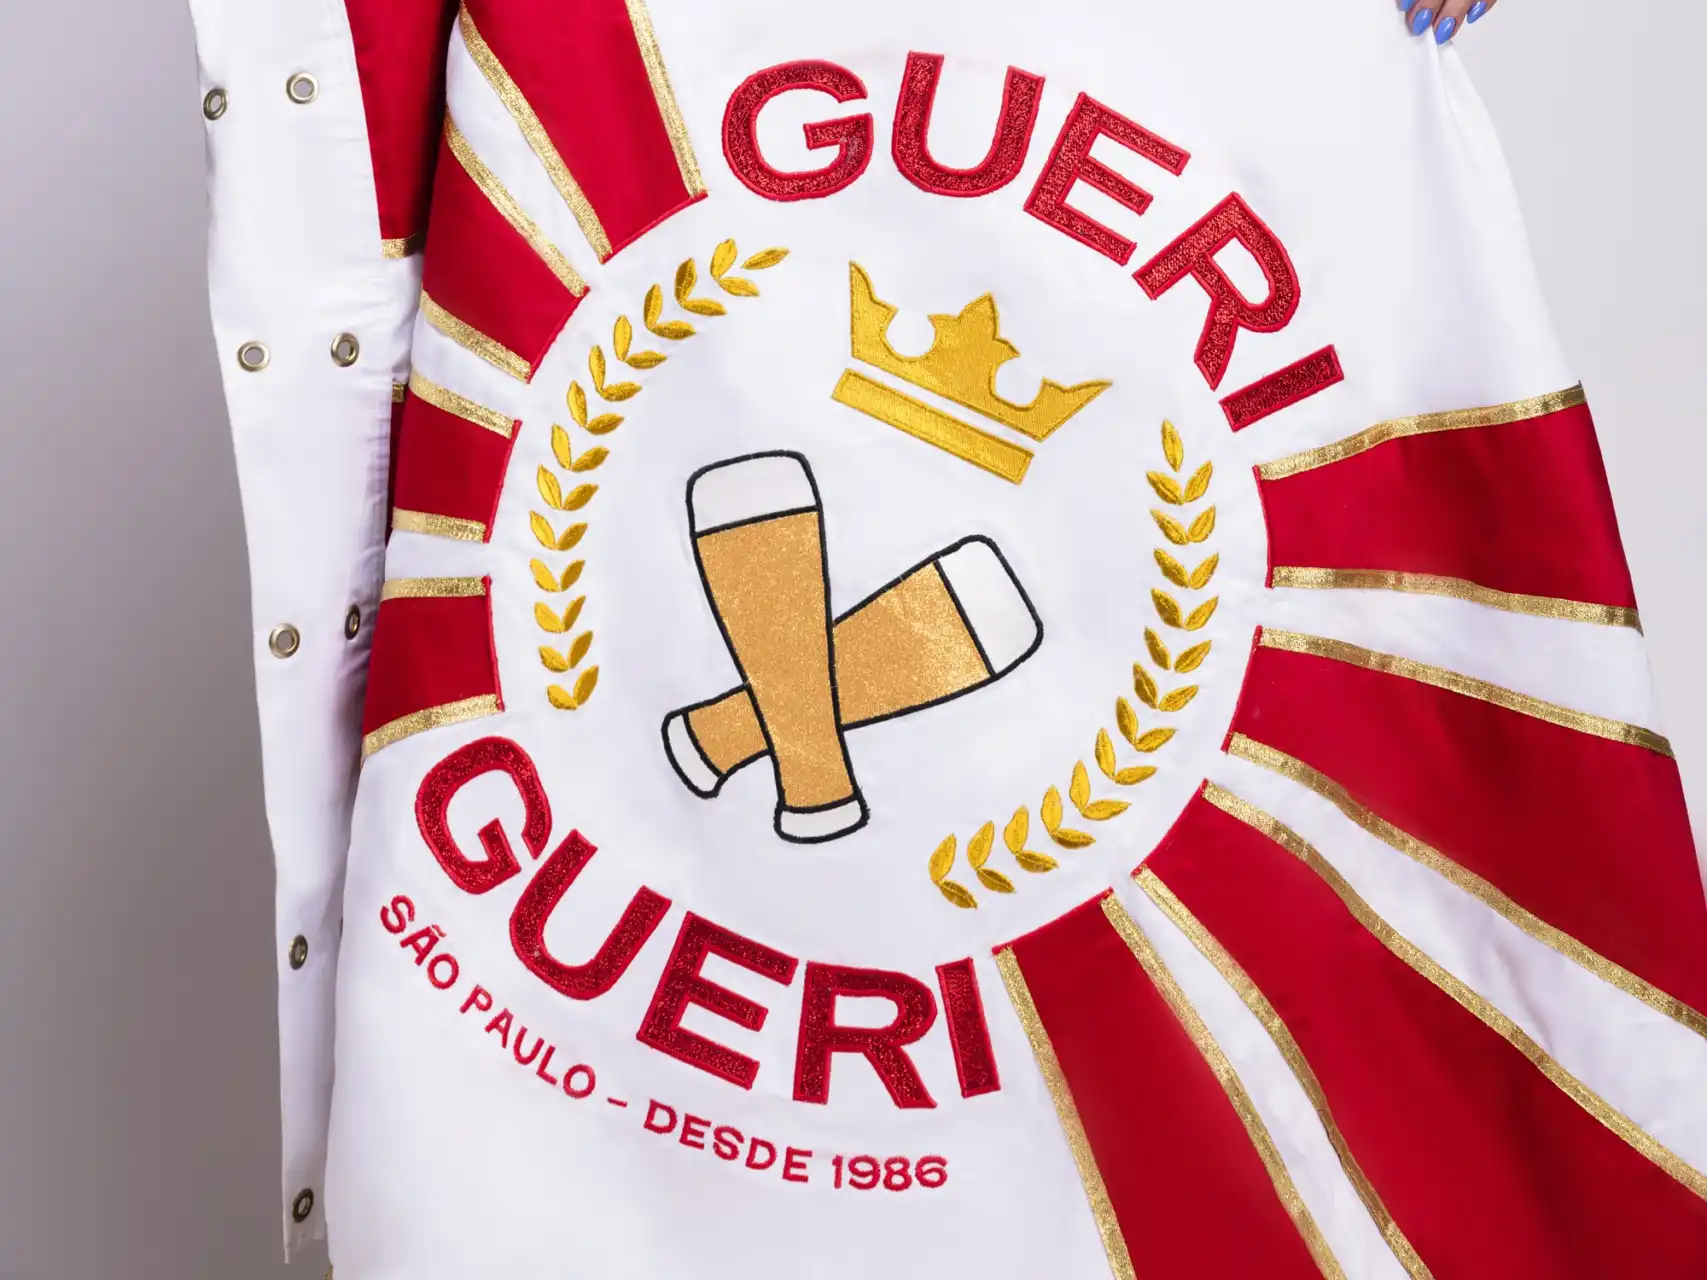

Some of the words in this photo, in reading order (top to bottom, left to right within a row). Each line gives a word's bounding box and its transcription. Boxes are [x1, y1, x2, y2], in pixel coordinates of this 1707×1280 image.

[721, 51, 1345, 433] GUERI
[379, 893, 461, 991] SÃO
[458, 984, 597, 1100] PAULO
[643, 1098, 814, 1184] DESDE
[830, 1153, 949, 1194] 1986
[414, 735, 1001, 1110] GUERI
